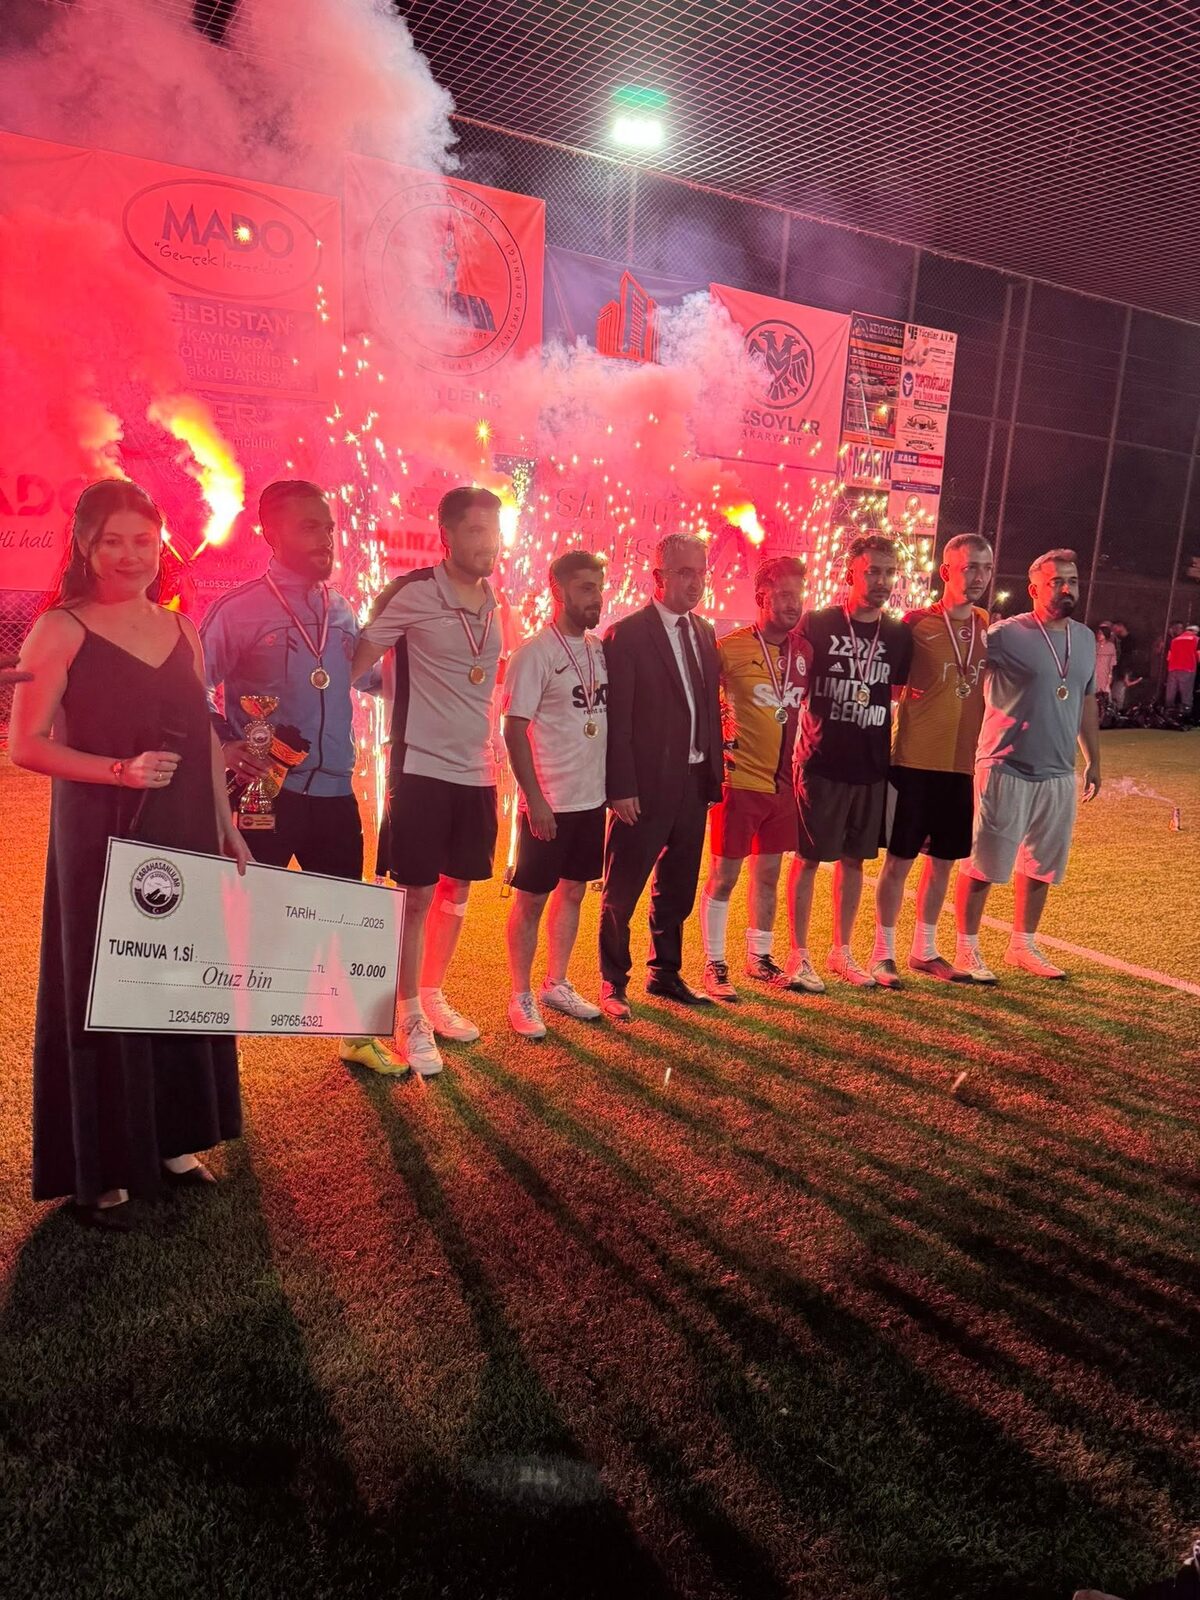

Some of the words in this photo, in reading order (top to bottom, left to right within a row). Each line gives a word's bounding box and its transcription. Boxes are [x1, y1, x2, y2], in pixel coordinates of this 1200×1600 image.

[161, 199, 294, 258] MADO
[187, 328, 274, 351] KAYNARCA
[19, 528, 54, 549] hali
[829, 700, 887, 730] BEHIND
[284, 904, 317, 921] TARİH
[108, 938, 168, 961] TURNUVA
[349, 962, 386, 979] 30.000
[201, 965, 241, 988] Otuz
[246, 972, 273, 990] bin
[167, 1009, 230, 1025] 123456789
[270, 1014, 324, 1028] 987654321
